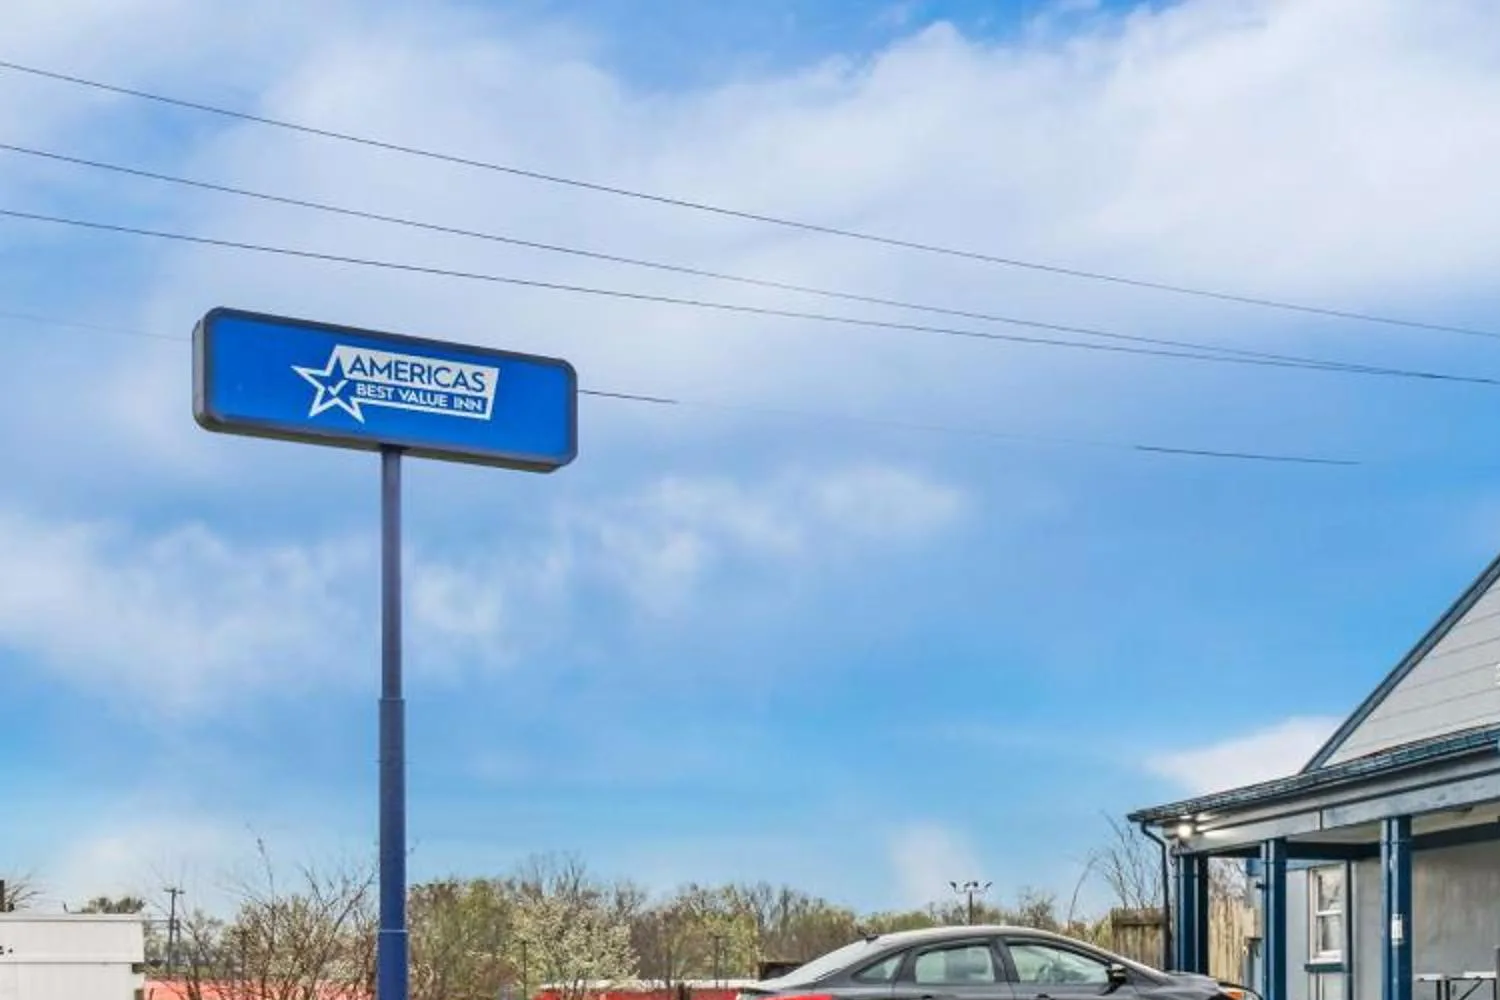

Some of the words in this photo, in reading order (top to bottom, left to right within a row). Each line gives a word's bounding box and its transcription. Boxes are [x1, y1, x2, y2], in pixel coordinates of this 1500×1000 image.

[348, 354, 486, 393] AMERICAS
[356, 383, 396, 401] BEST
[399, 388, 449, 407] VALUE
[453, 397, 483, 412] INN
